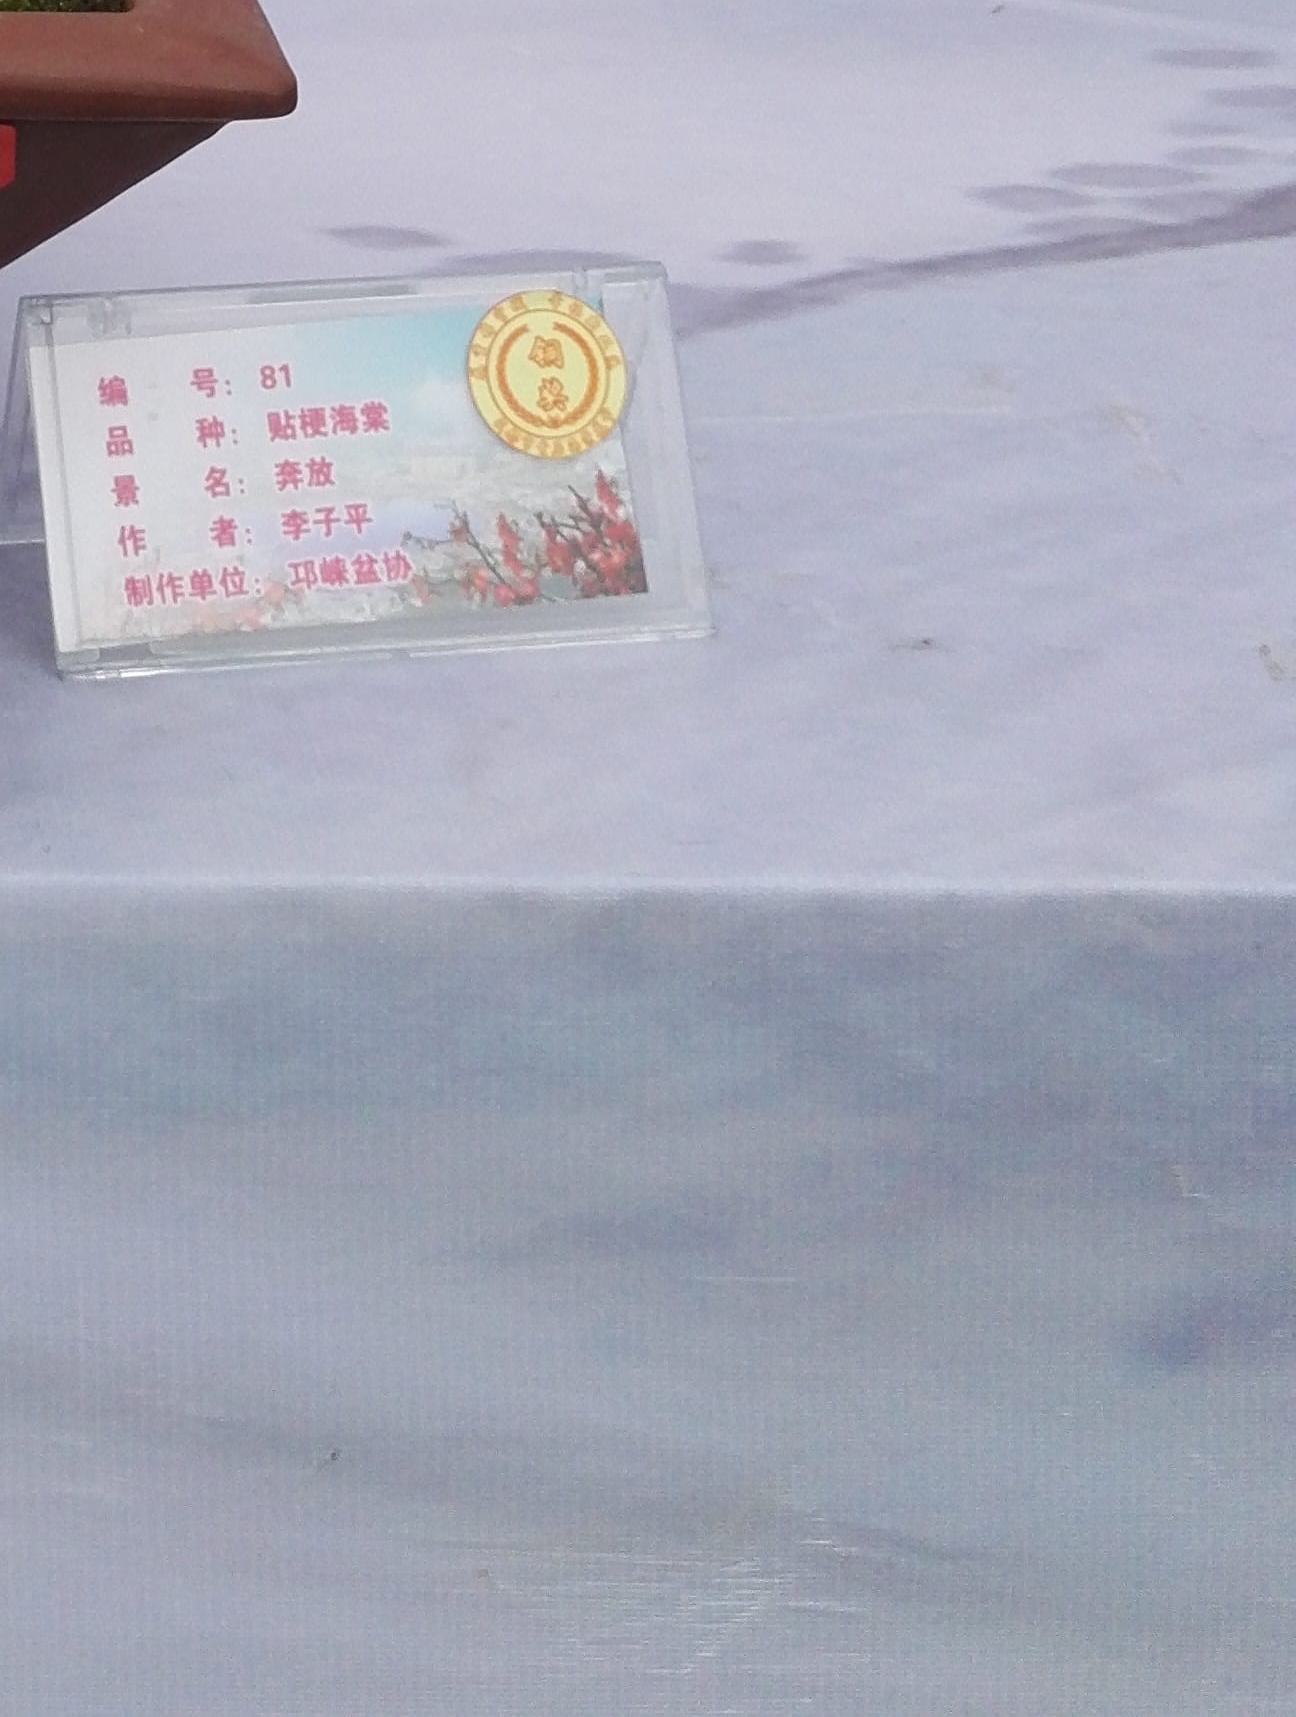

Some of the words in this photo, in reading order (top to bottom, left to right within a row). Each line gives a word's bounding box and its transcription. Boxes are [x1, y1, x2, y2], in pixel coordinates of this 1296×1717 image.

[259, 364, 293, 390] 81
[274, 457, 336, 492] 奔放
[280, 503, 373, 541] 李子平
